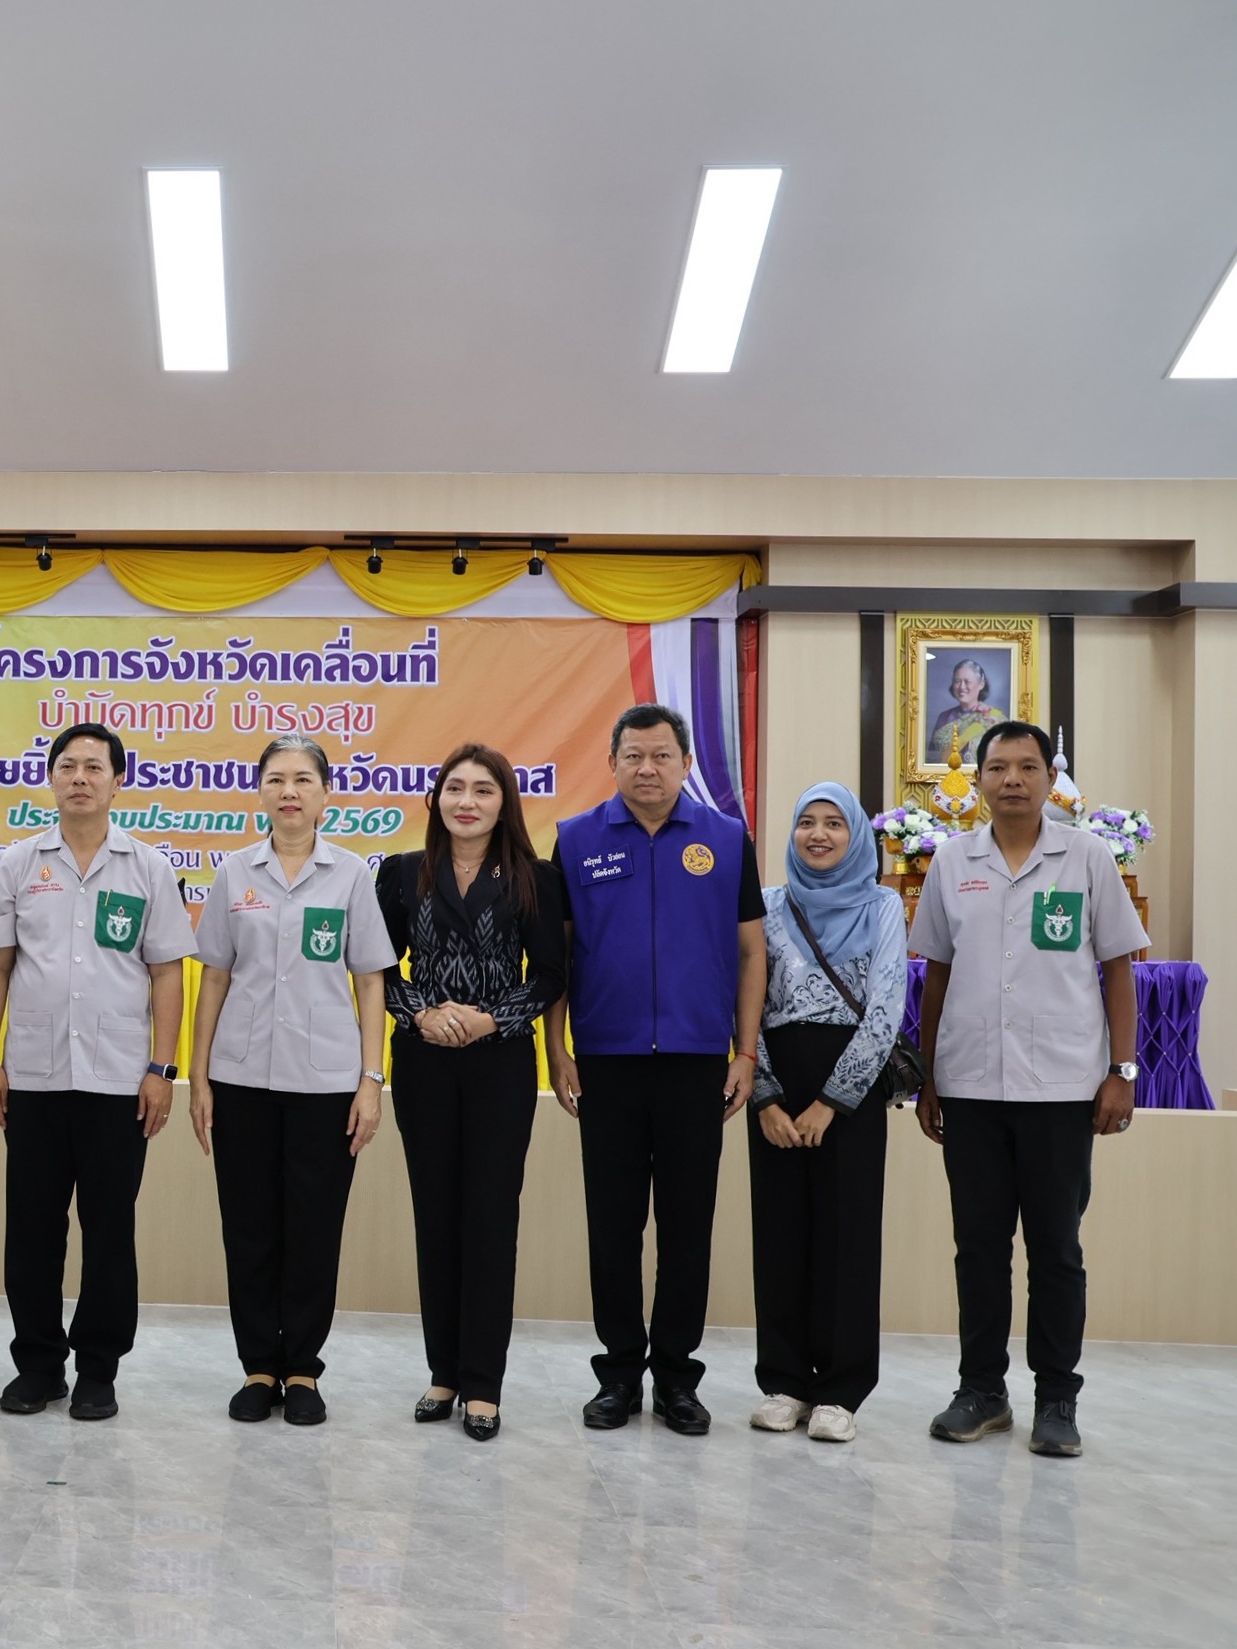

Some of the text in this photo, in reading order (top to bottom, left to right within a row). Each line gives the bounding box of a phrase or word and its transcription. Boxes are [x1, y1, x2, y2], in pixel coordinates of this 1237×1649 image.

[40, 688, 374, 742] บำบัดทุกข์ บำรงสุข
[320, 808, 403, 834] 2569
